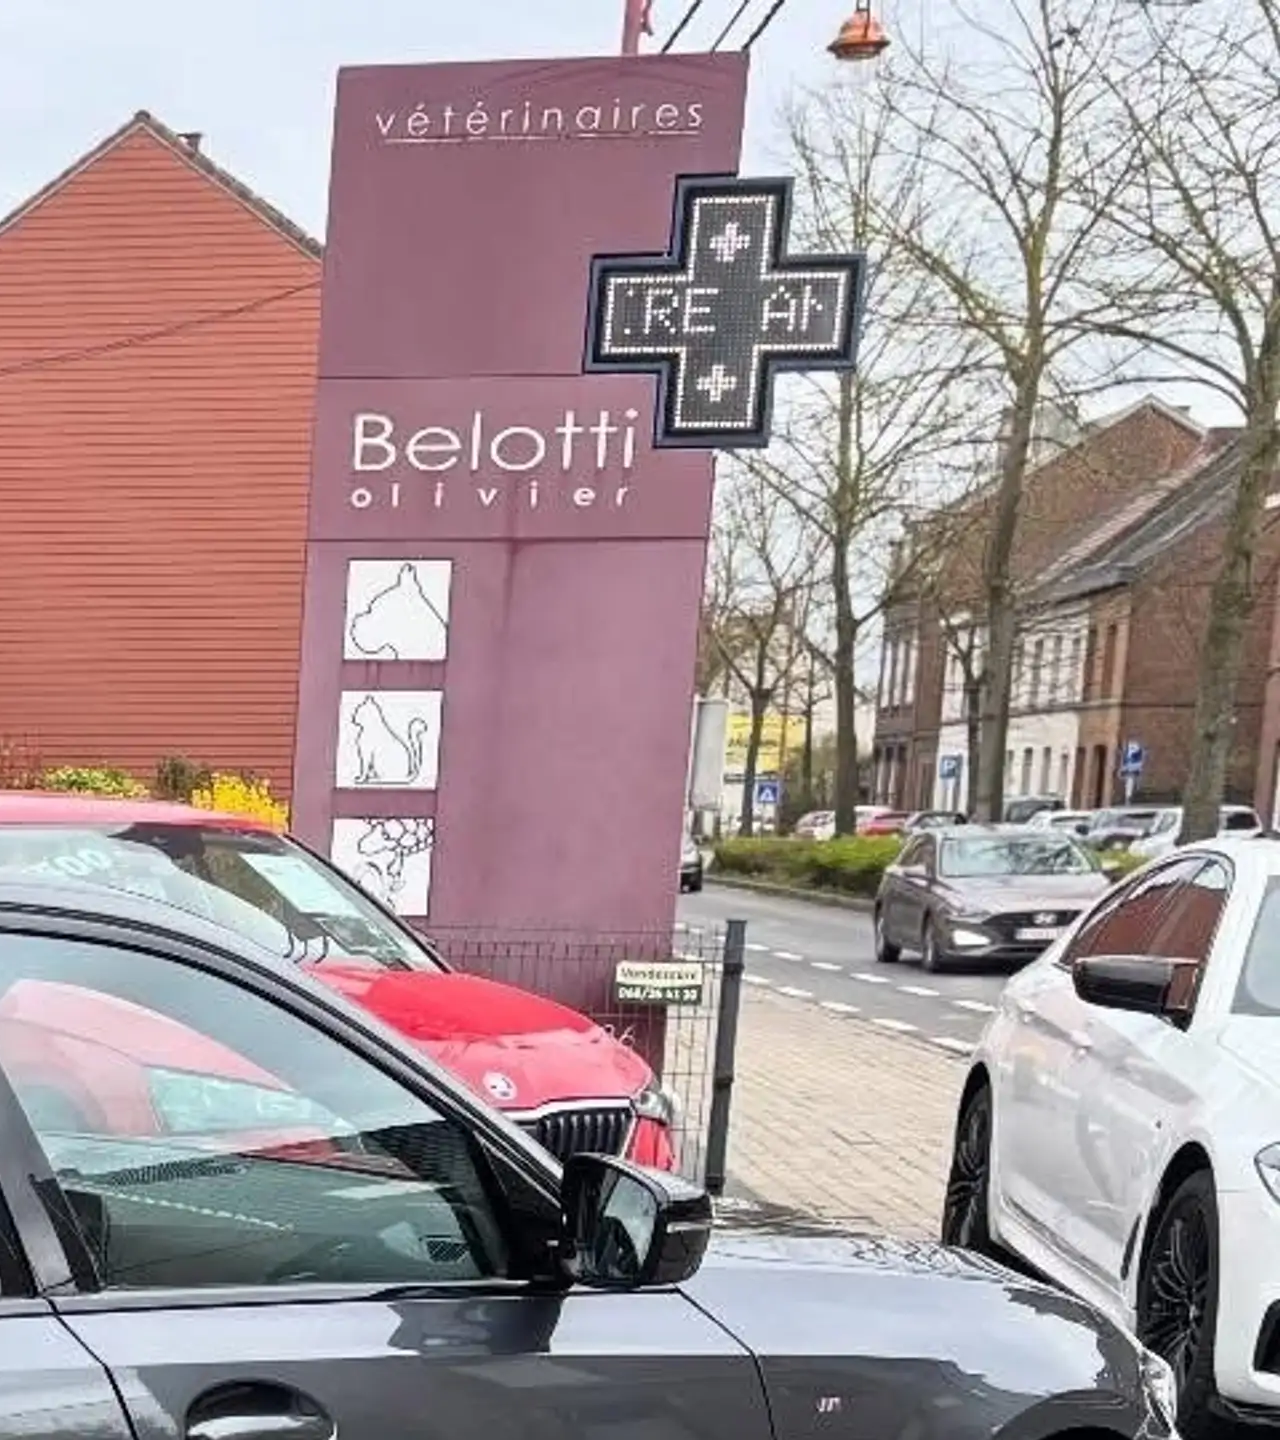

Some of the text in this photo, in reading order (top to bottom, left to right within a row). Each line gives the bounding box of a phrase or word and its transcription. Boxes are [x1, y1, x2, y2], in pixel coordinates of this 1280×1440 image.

[374, 98, 703, 137] vétérinaires
[352, 407, 640, 471] Belotti
[350, 482, 631, 508] olivier
